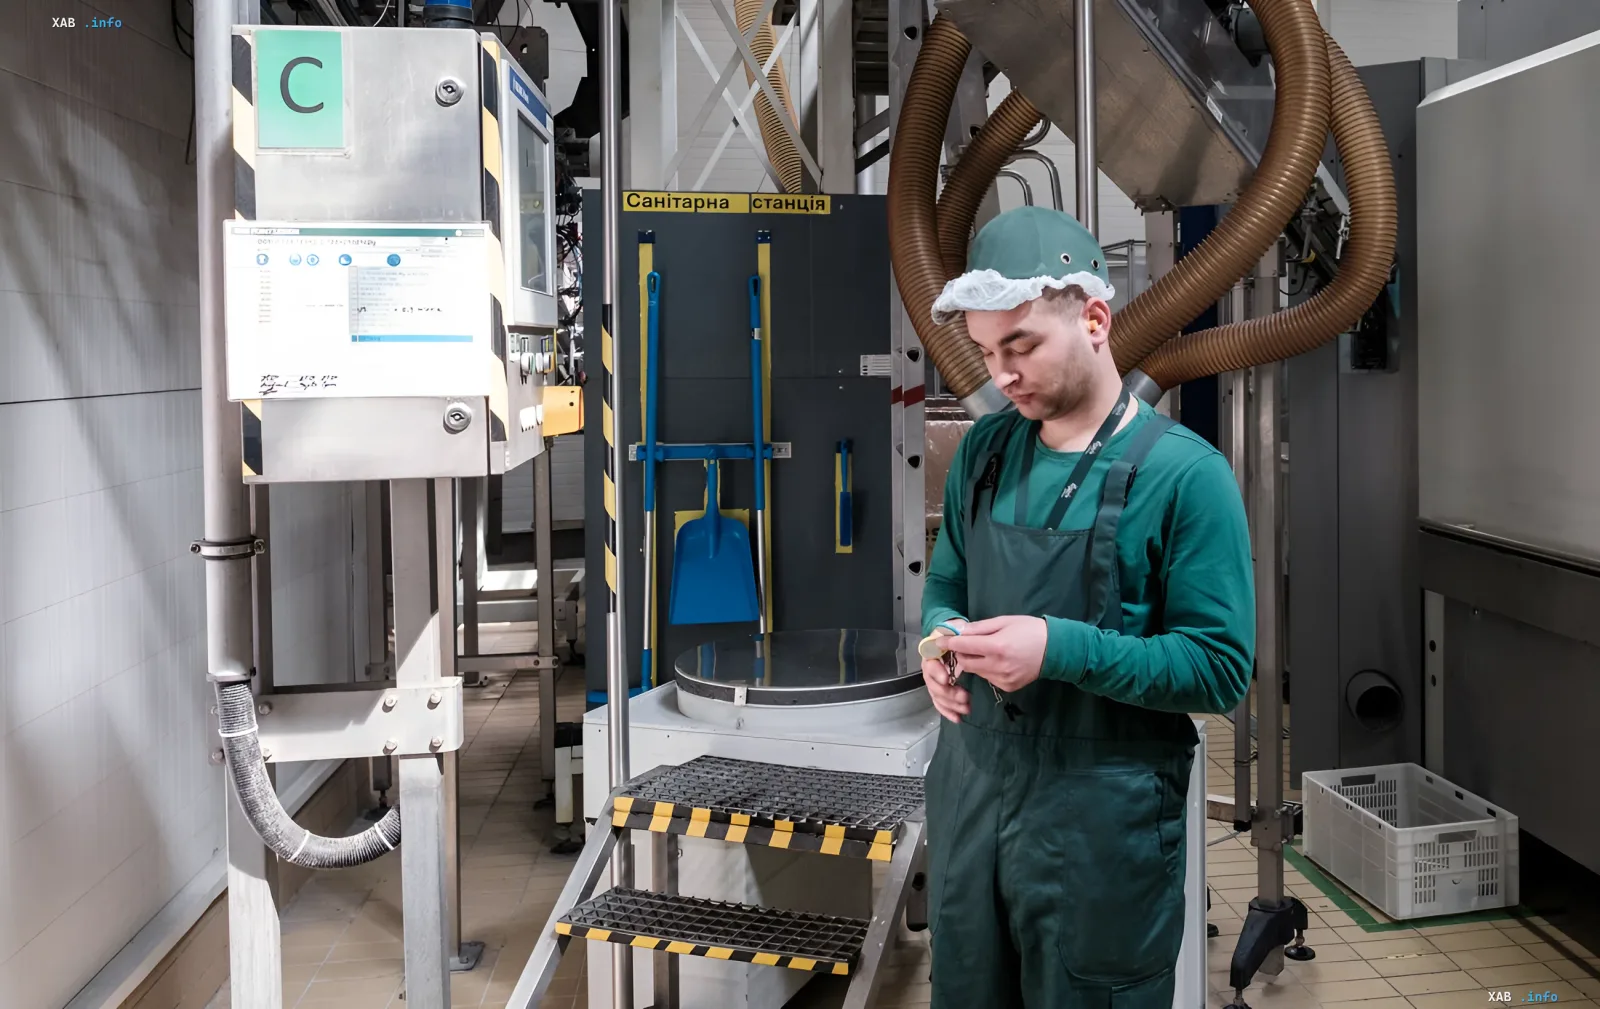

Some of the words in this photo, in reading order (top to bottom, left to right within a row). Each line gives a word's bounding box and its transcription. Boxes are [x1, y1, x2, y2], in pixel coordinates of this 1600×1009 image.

[280, 56, 324, 113] C
[626, 193, 730, 212] Санітарна
[752, 195, 826, 212] станція
